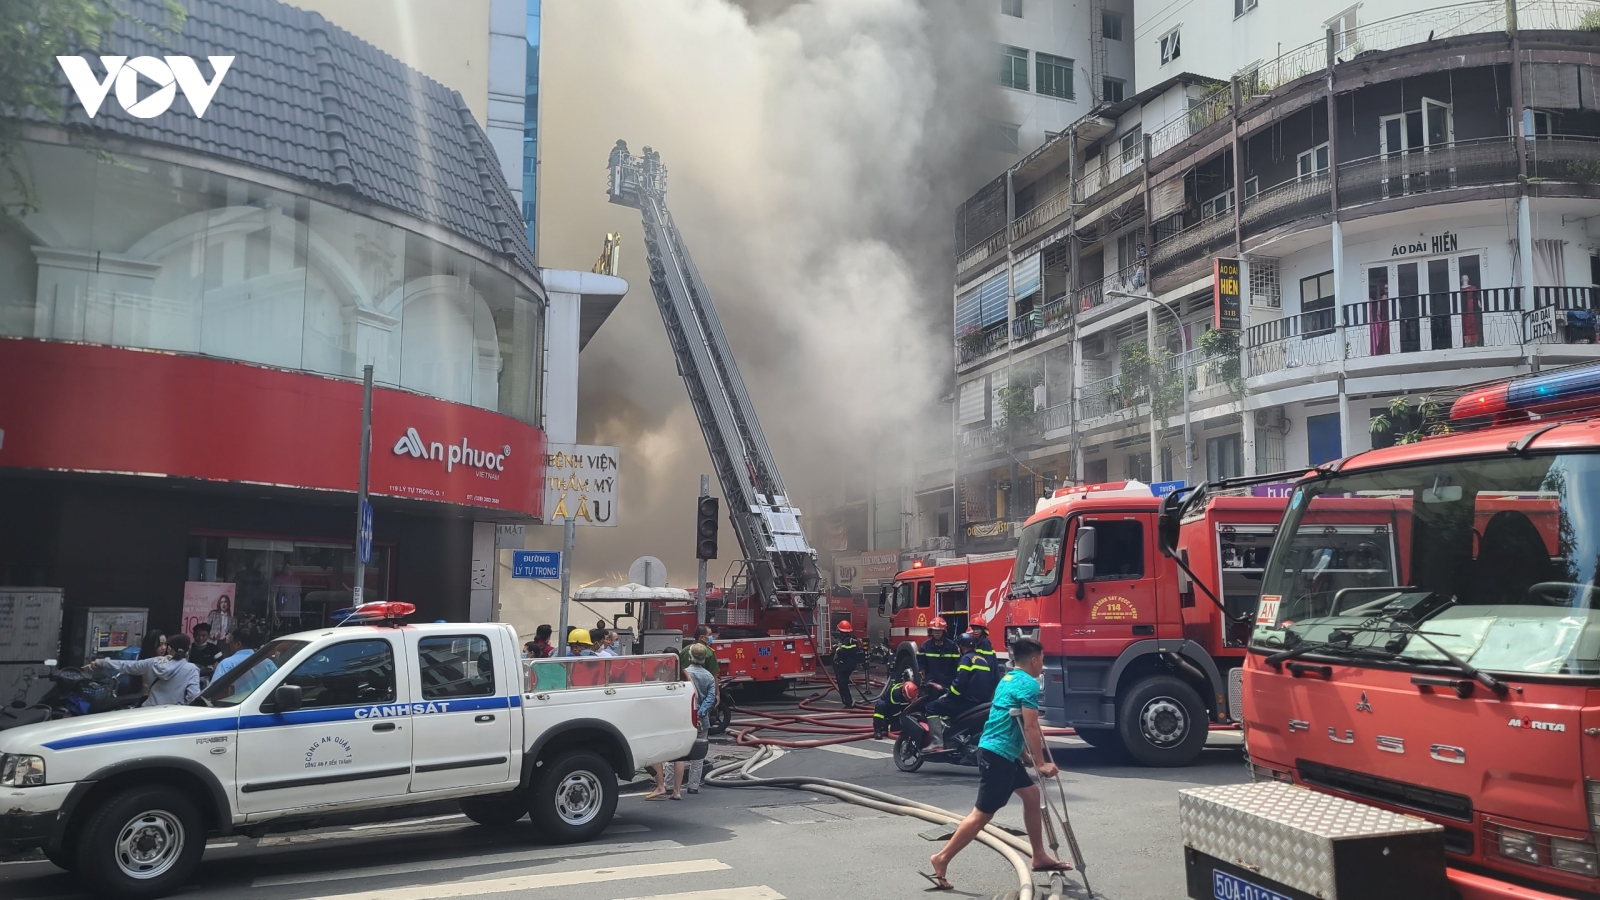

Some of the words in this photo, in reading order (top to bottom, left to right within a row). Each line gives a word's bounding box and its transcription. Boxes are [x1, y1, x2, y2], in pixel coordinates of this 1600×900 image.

[1392, 244, 1406, 256] ÁO
[1408, 241, 1427, 254] DÀI
[1431, 230, 1458, 253] HIỀN
[1223, 309, 1237, 317] 31B
[587, 453, 617, 472] VIỆN
[475, 470, 500, 481] VIETNAM
[388, 484, 399, 492] 119
[399, 484, 407, 493] LÝ
[594, 476, 615, 493] MỸ
[523, 554, 551, 564] ĐƯỜNG
[515, 564, 523, 576] LÝ
[525, 566, 535, 577] TỰ
[535, 567, 557, 578] TRỌNG
[354, 701, 412, 719] CẢNH
[412, 700, 450, 715] SÁT
[321, 735, 331, 744] AN
[1288, 718, 1466, 764] FUSO
[1215, 873, 1281, 900] 50A-01
